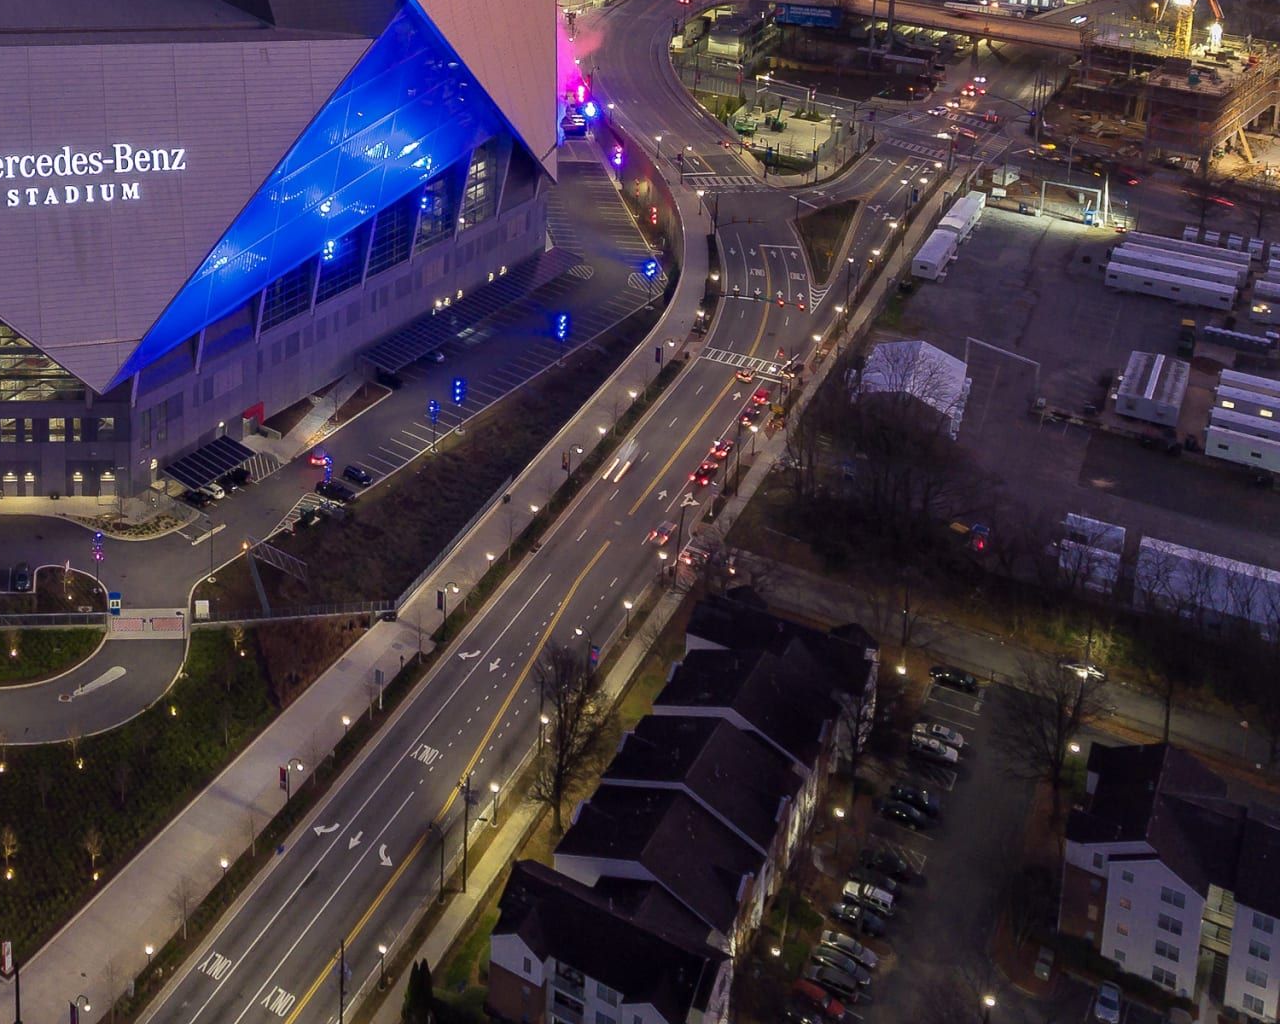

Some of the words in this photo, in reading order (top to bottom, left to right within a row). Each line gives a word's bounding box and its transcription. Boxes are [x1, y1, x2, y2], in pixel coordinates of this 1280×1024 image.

[7, 182, 140, 207] STADIUM
[410, 743, 439, 765] ONLY
[197, 951, 232, 981] ONLY
[260, 986, 296, 1017] ONLY
